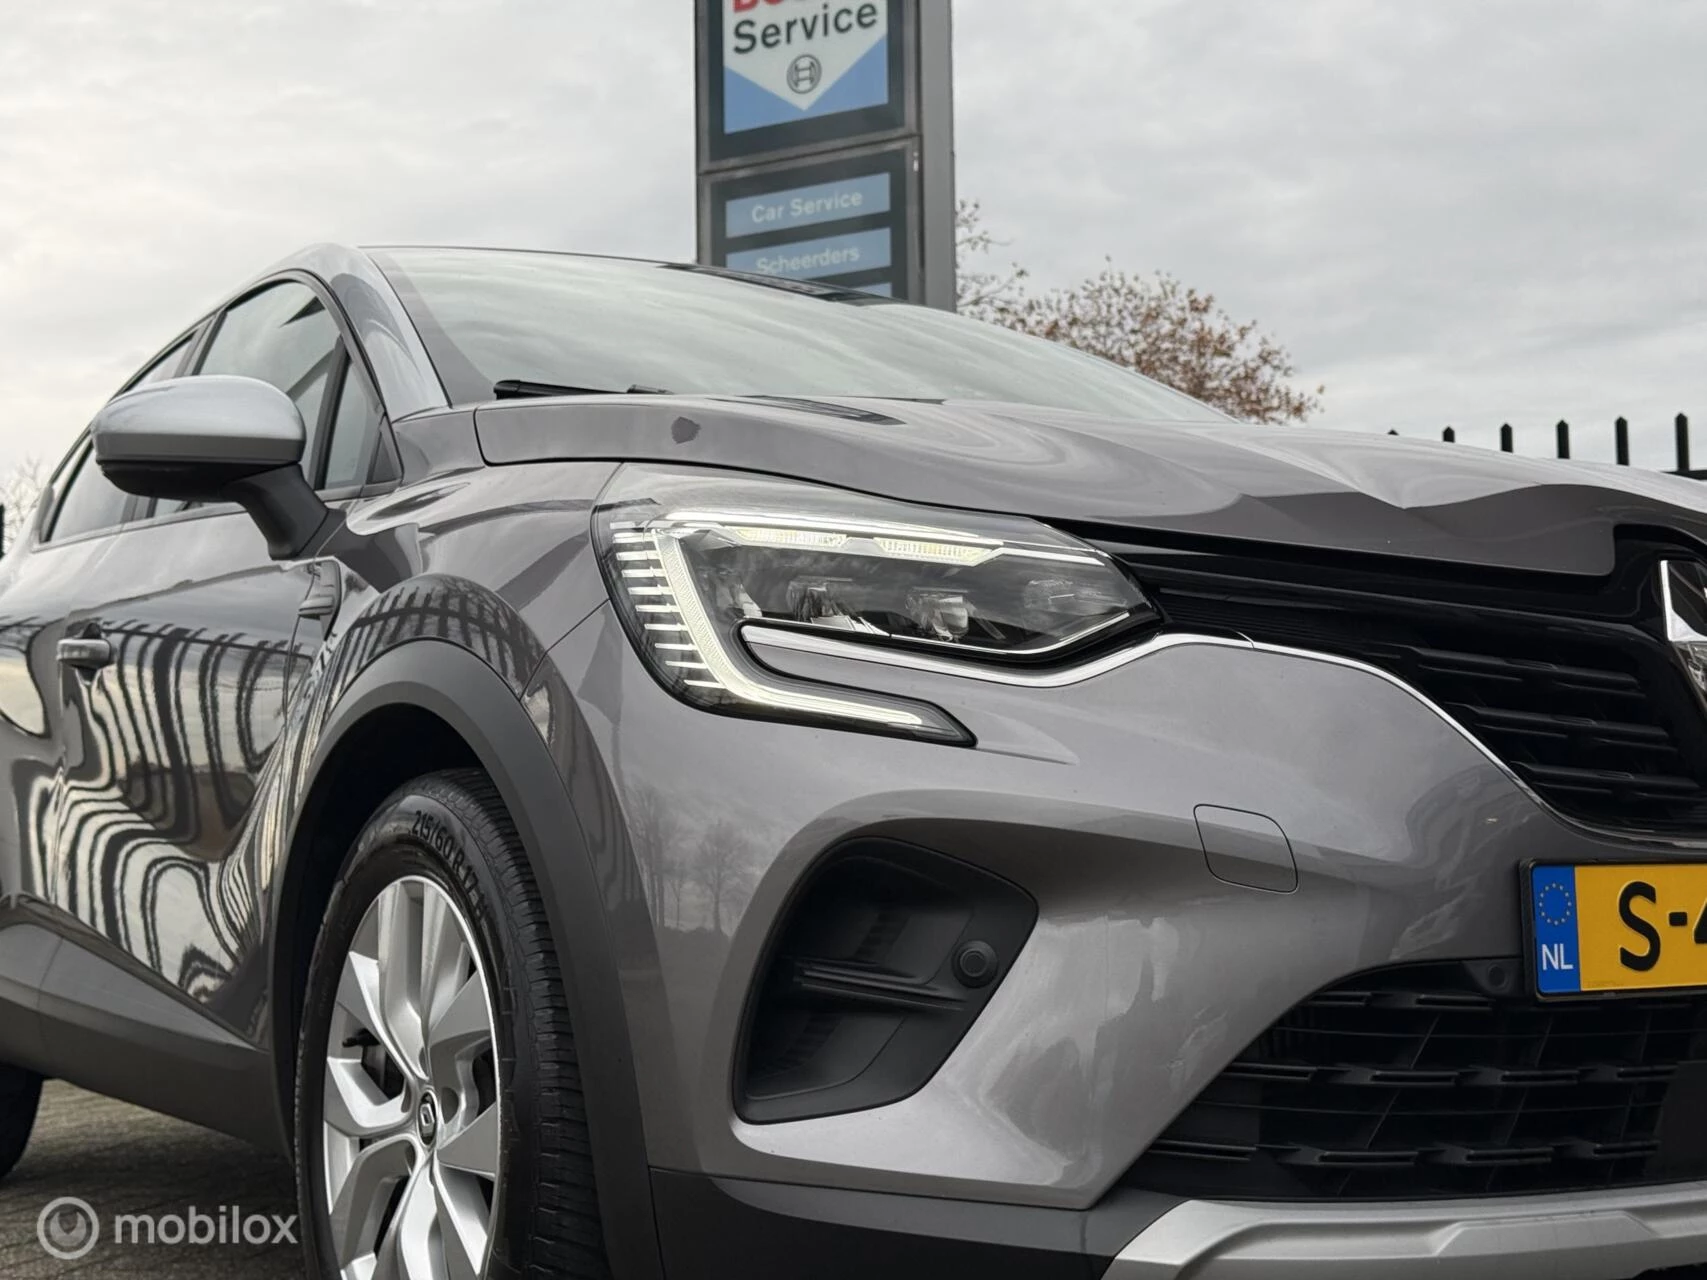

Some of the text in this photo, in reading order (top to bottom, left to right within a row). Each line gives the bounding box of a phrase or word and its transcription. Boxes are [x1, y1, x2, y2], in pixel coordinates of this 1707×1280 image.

[734, 3, 878, 54] Service
[752, 190, 863, 223] Car Service
[756, 246, 860, 275] Scheerders
[1541, 943, 1574, 971] NL
